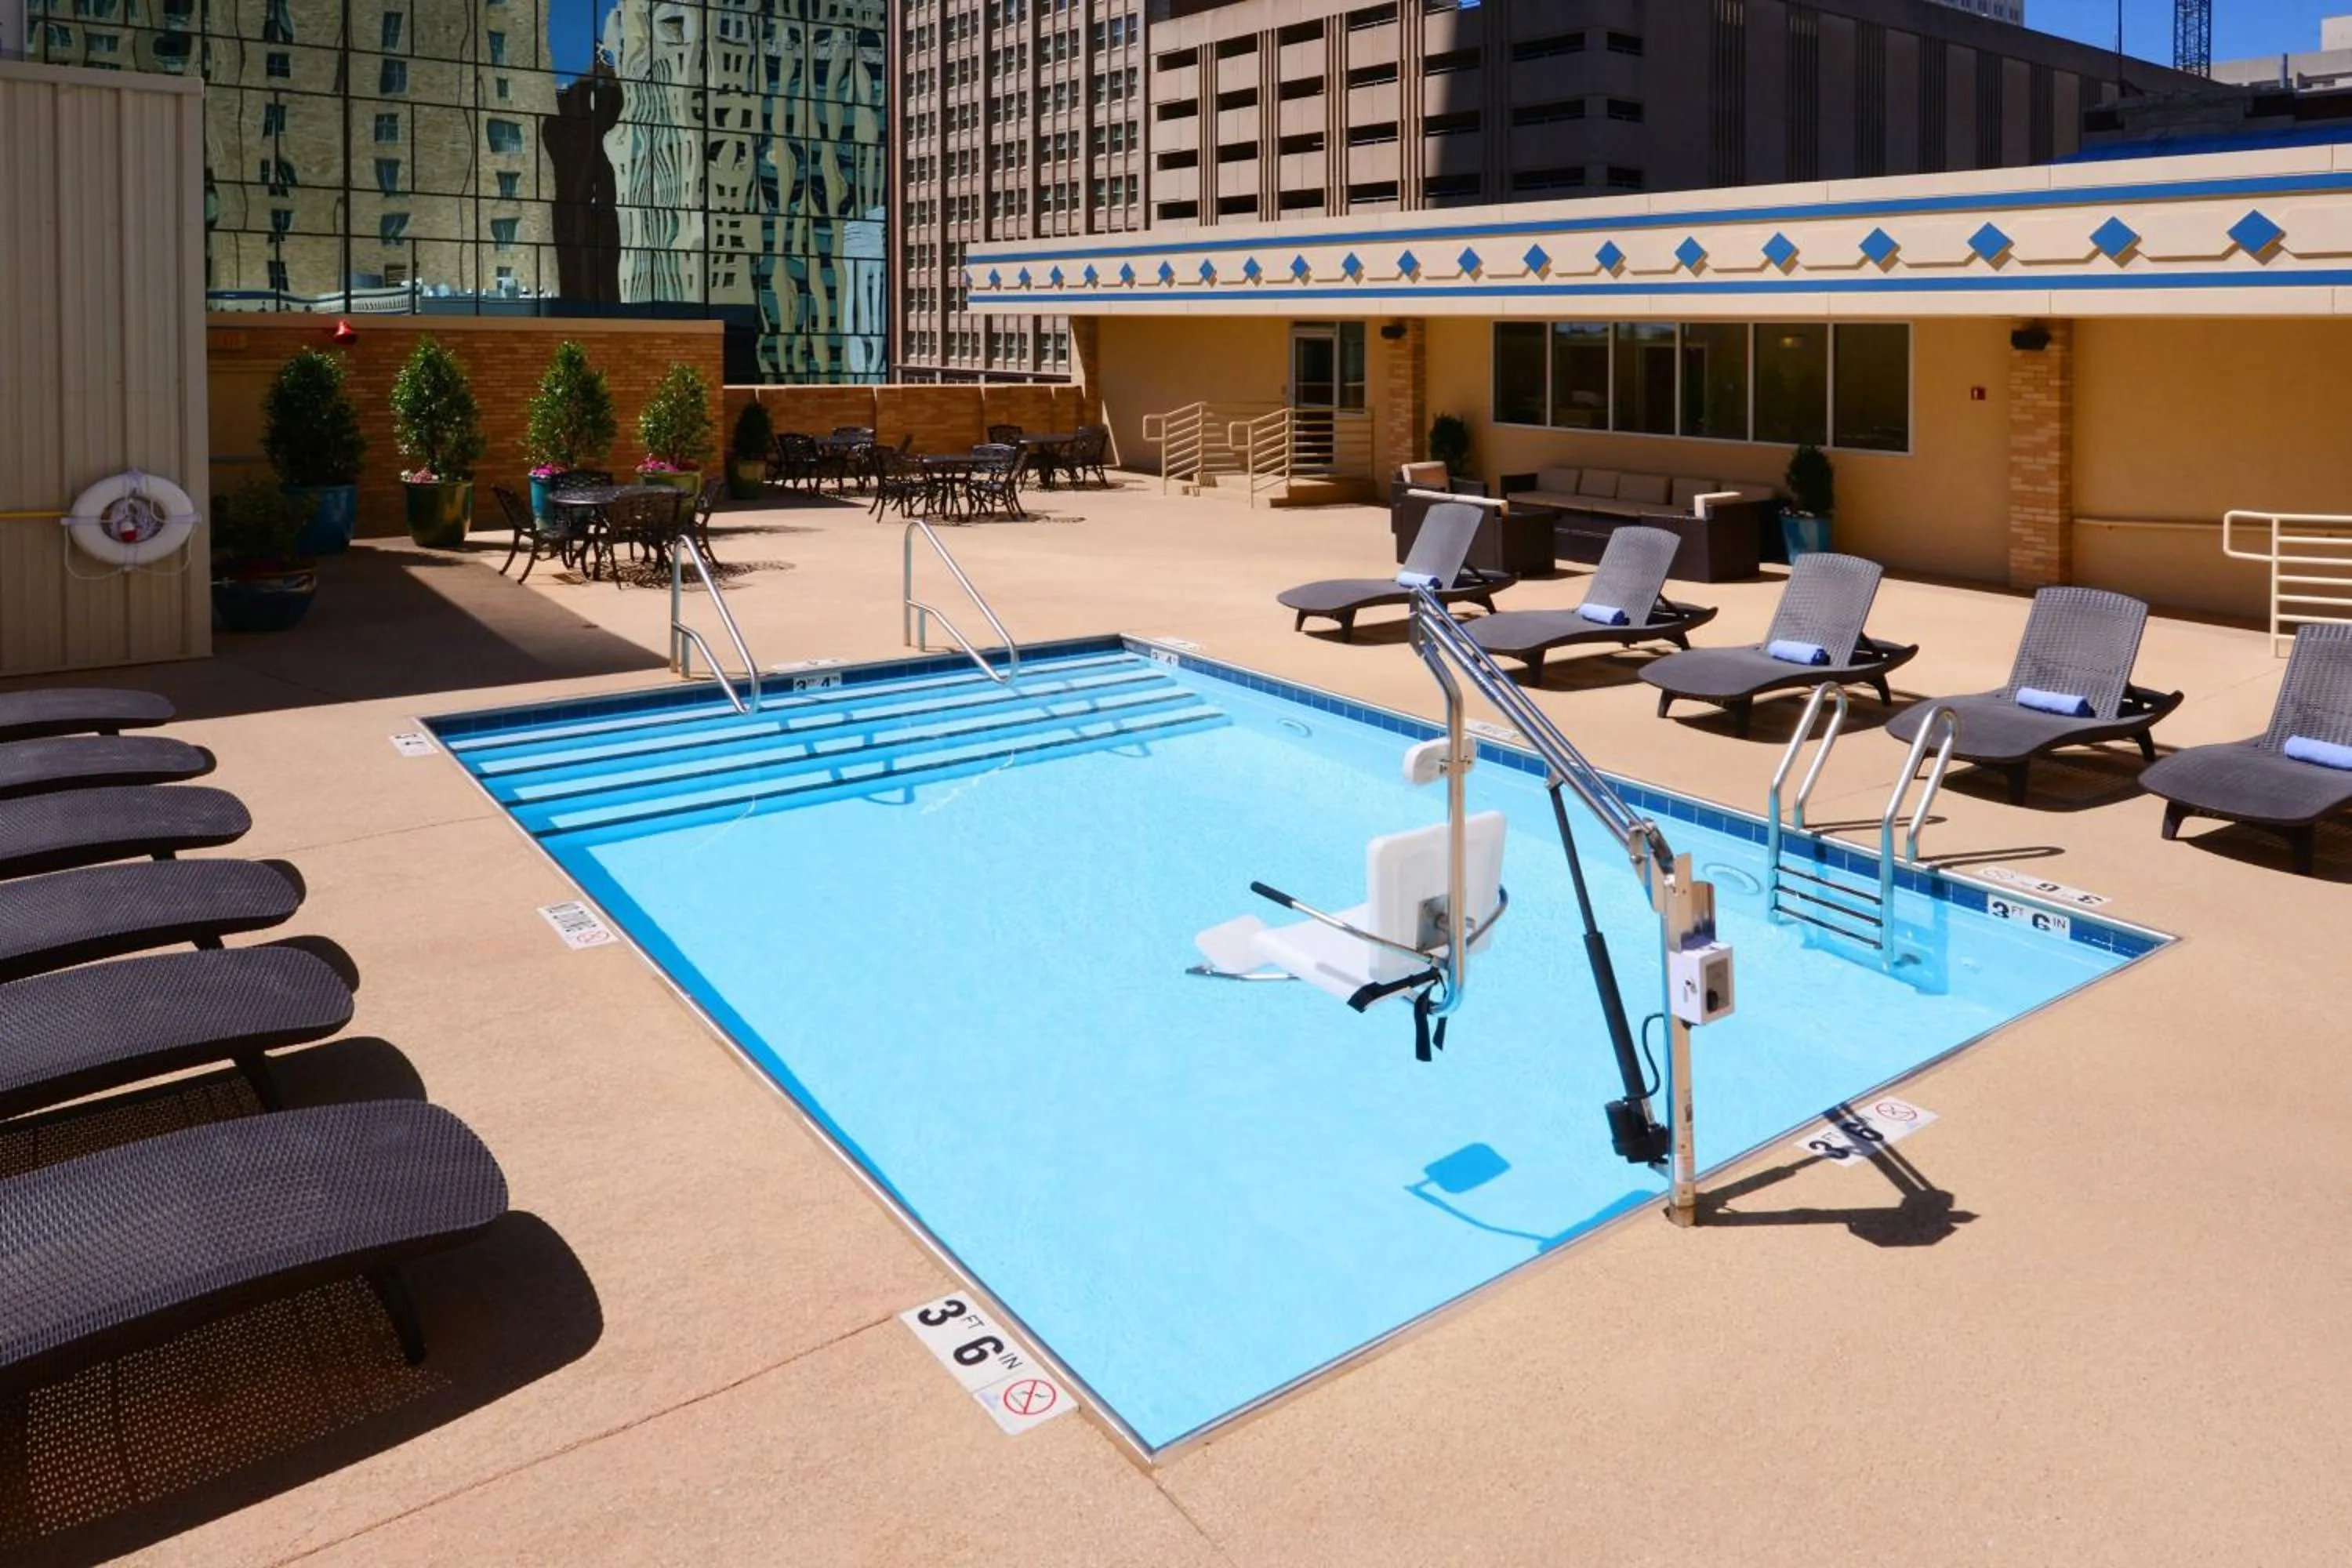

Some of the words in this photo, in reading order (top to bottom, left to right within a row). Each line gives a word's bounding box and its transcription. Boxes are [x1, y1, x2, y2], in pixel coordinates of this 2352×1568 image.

[1992, 902, 2009, 919] 3
[2012, 906, 2024, 916] FT
[2053, 916, 2067, 928] IN
[1809, 1141, 1850, 1160] 3
[1842, 1122, 1884, 1142] 6
[917, 1299, 967, 1327] 3
[961, 1314, 985, 1330] FT
[953, 1335, 1004, 1367] 6
[998, 1352, 1023, 1370] IN
